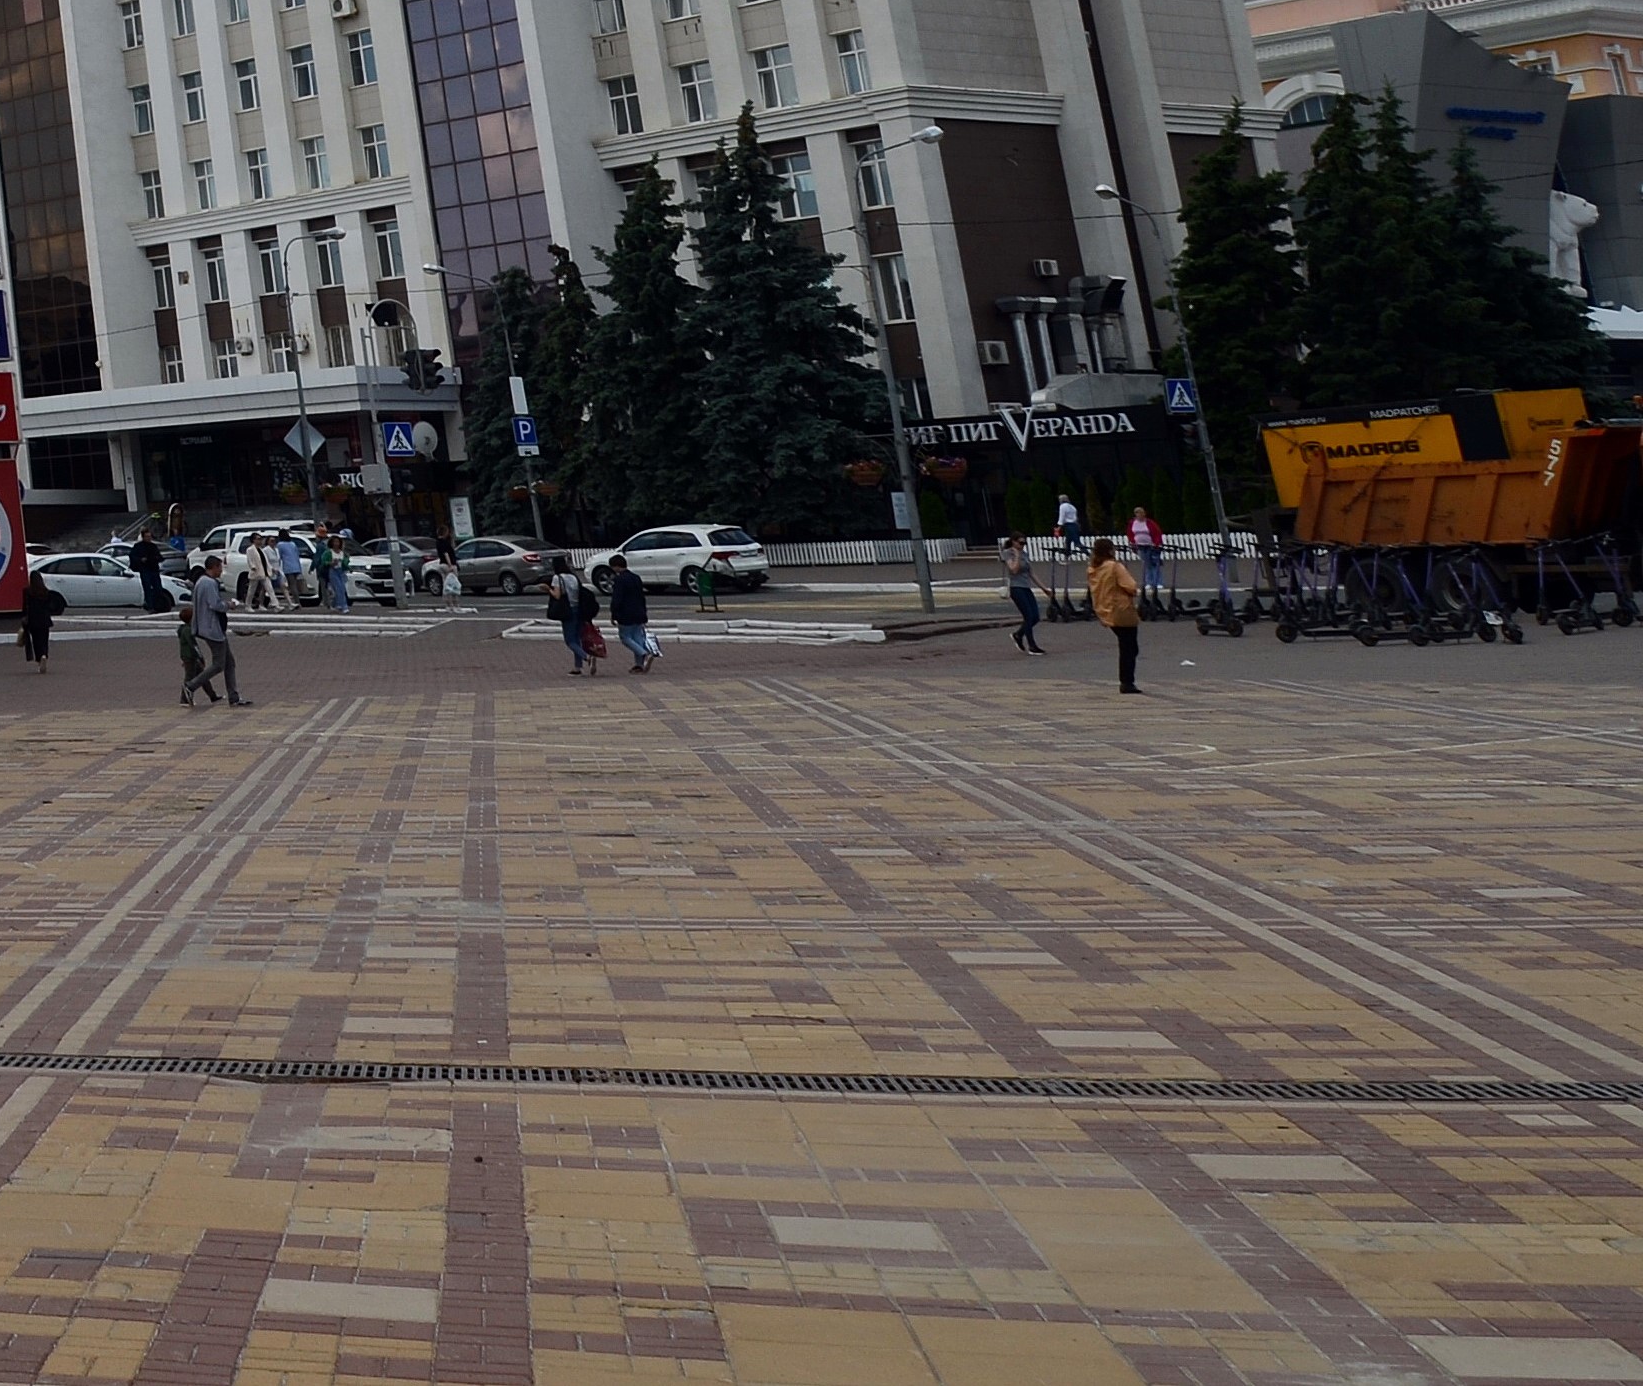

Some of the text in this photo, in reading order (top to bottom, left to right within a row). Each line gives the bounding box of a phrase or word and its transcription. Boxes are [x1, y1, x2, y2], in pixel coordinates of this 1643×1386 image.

[1369, 405, 1440, 419] MADPATCHER
[519, 421, 531, 441] P
[947, 421, 1004, 443] ПИГ
[1326, 440, 1420, 459] MADROG
